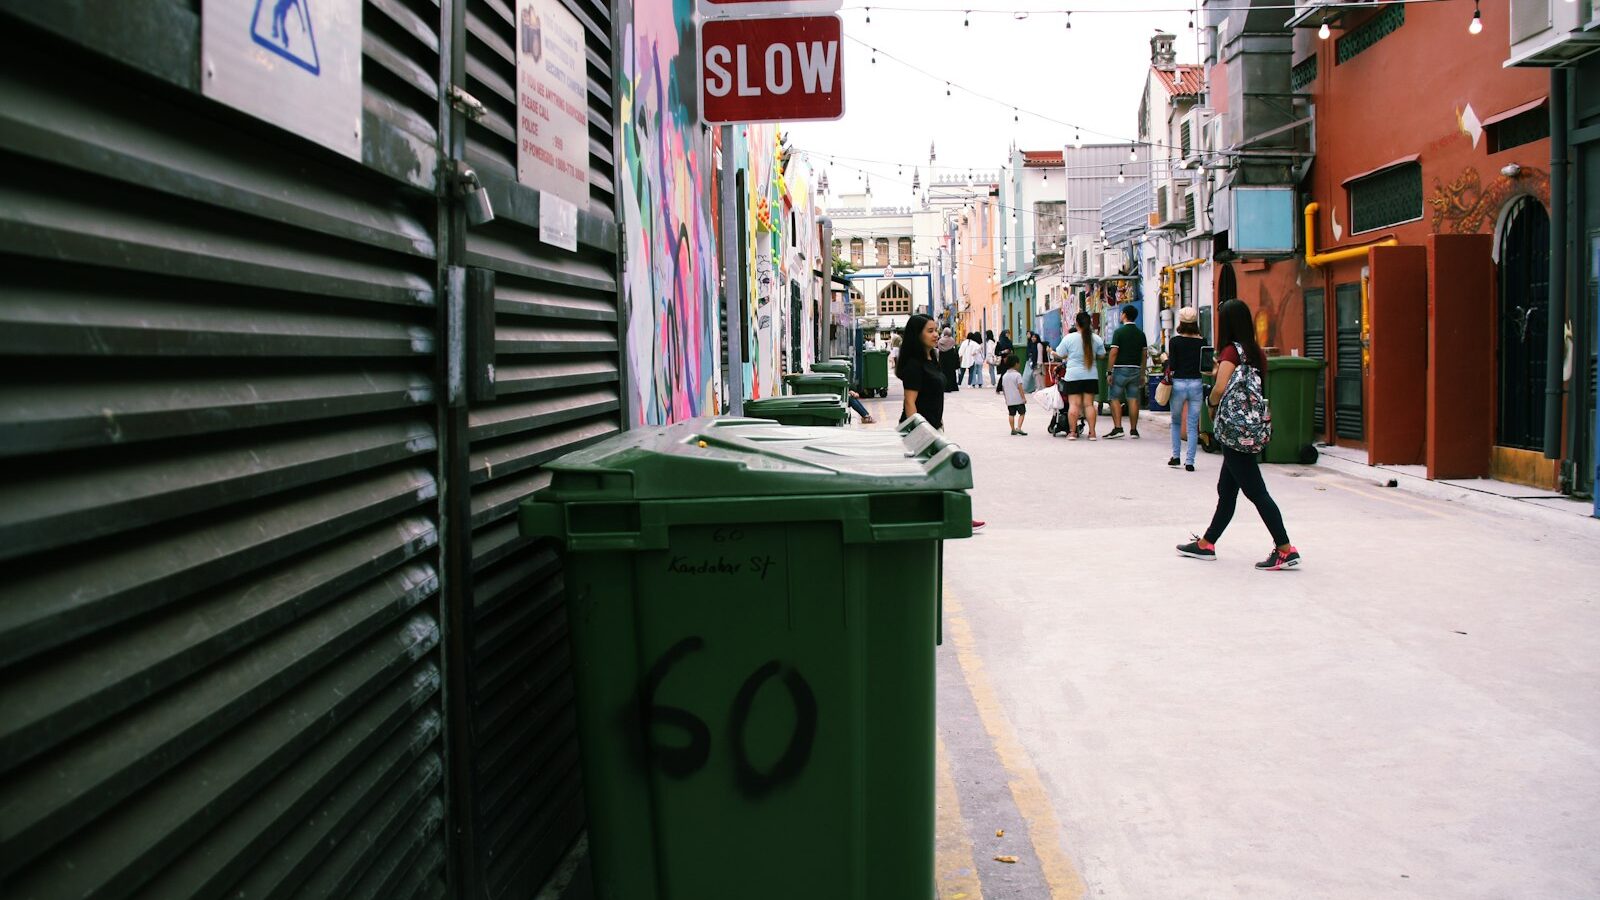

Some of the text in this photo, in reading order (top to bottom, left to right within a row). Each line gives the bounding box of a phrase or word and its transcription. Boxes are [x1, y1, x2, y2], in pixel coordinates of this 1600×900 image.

[705, 41, 838, 97] SLOW
[521, 92, 550, 122] PLEASE CALL
[537, 81, 545, 97] SEE
[546, 87, 565, 112] ANYTHING
[521, 115, 539, 136] POLICE
[713, 527, 744, 542] 60
[750, 555, 776, 580] St
[633, 635, 818, 800] 60
